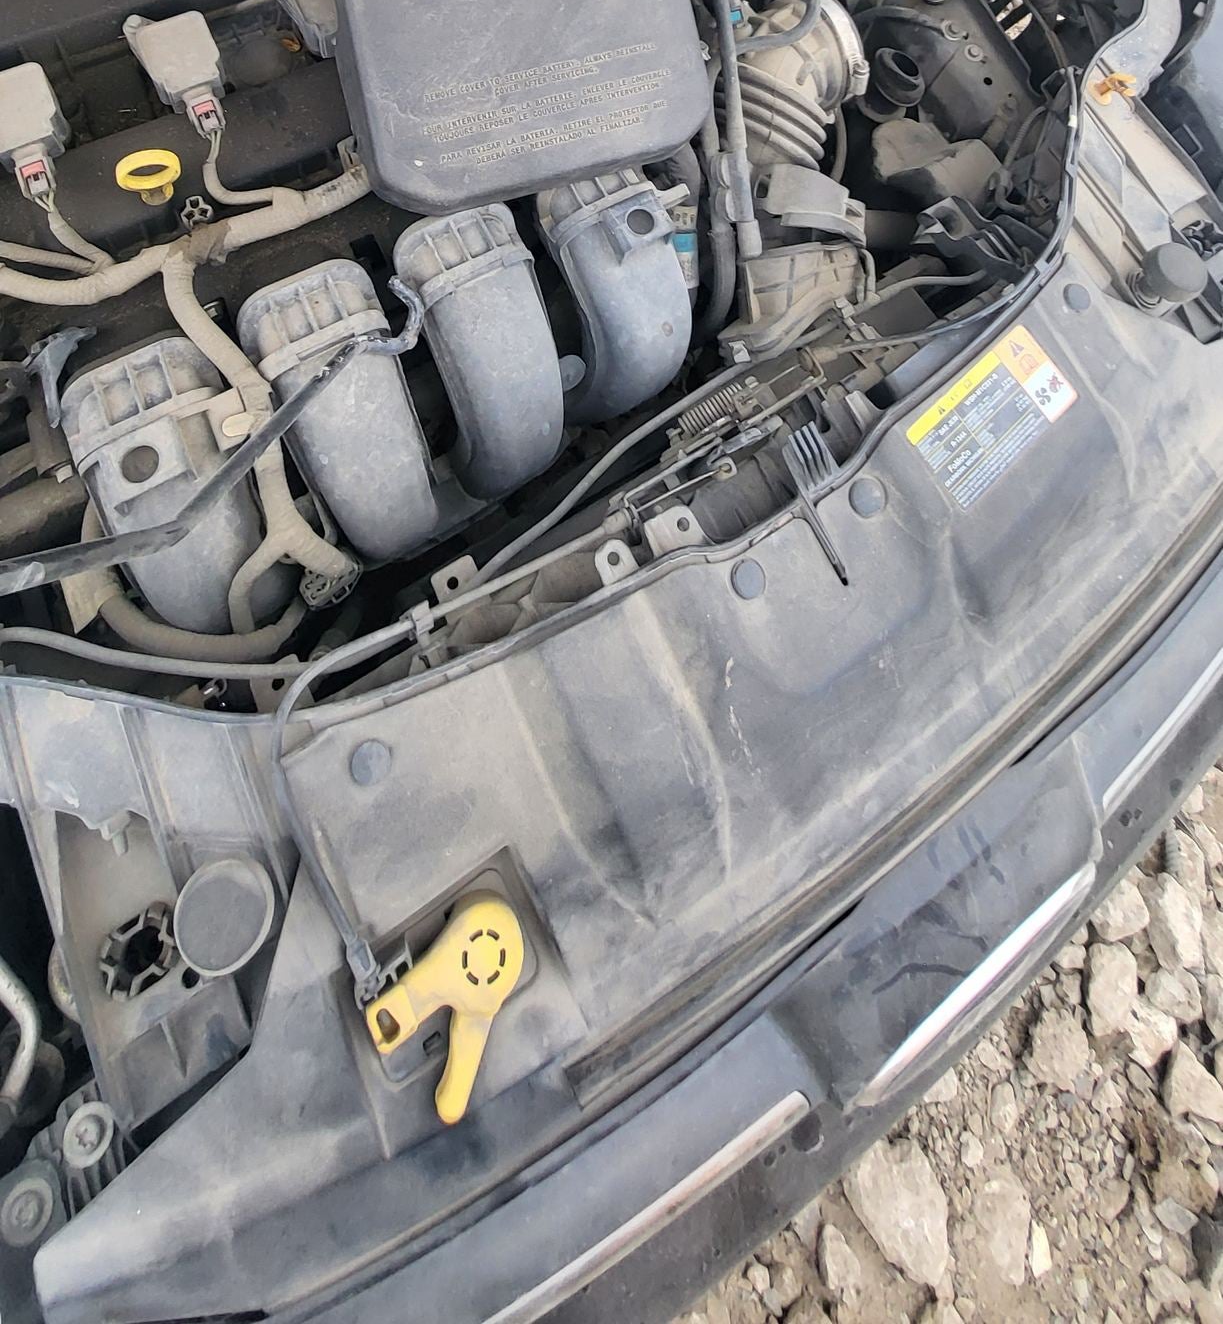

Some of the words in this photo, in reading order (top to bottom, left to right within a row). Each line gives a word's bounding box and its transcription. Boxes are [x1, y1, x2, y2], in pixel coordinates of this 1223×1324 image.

[424, 88, 455, 102] REMOVE
[459, 80, 487, 93] COVER
[489, 77, 500, 86] TO
[504, 67, 538, 82] SERVICE
[583, 51, 612, 64] ALWAYS
[493, 83, 519, 96] COVER
[523, 76, 547, 88] AFTER
[550, 64, 598, 82] SERVICING.
[433, 126, 474, 143] TOUJOURS
[478, 116, 514, 131] REPOSER
[518, 112, 528, 121] LE
[532, 100, 576, 118] COUVERCLE
[579, 94, 603, 106] APRES
[447, 109, 497, 128] INTERVENIR
[500, 105, 516, 115] SUR
[520, 101, 531, 110] LA
[581, 81, 614, 95] ENLEVER
[617, 78, 627, 86] LE
[440, 150, 462, 163] PARA
[465, 141, 501, 156] REVISAR
[505, 137, 516, 146] LA
[562, 117, 593, 131] RETIRE
[595, 115, 604, 123] EL
[608, 103, 649, 120] PROTECTOR
[510, 145, 525, 155] SER
[528, 130, 582, 150] REINSTALADO
[586, 127, 596, 135] AL
